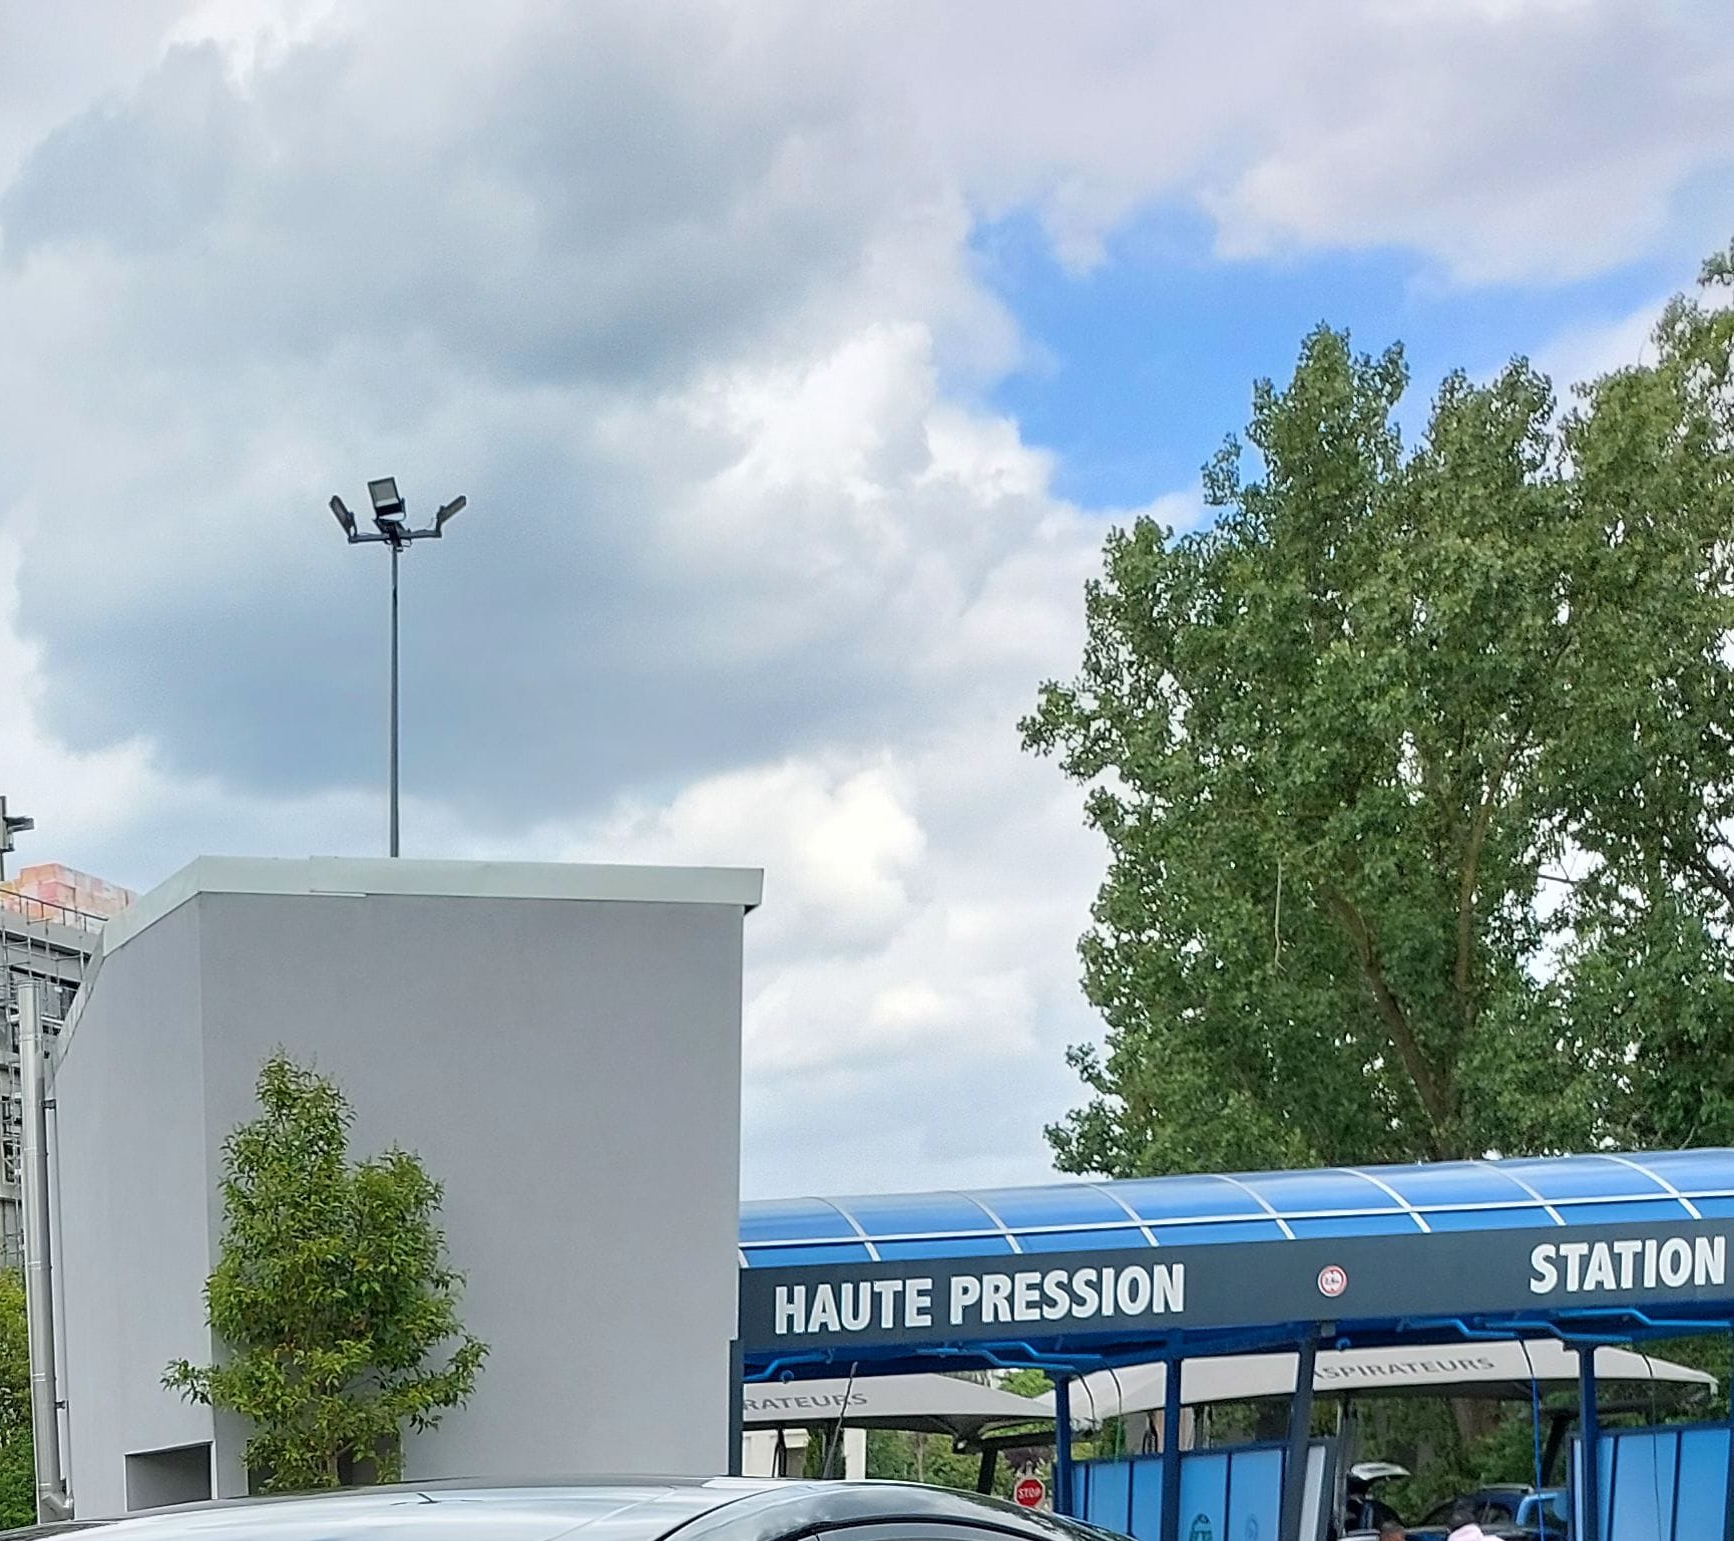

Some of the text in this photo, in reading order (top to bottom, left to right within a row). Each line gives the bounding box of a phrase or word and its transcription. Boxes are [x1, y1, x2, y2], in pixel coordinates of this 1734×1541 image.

[1529, 1235, 1726, 1294] STATION
[774, 1263, 1185, 1335] HAUTE PRESSION
[1018, 1487, 1041, 1499] STOP
